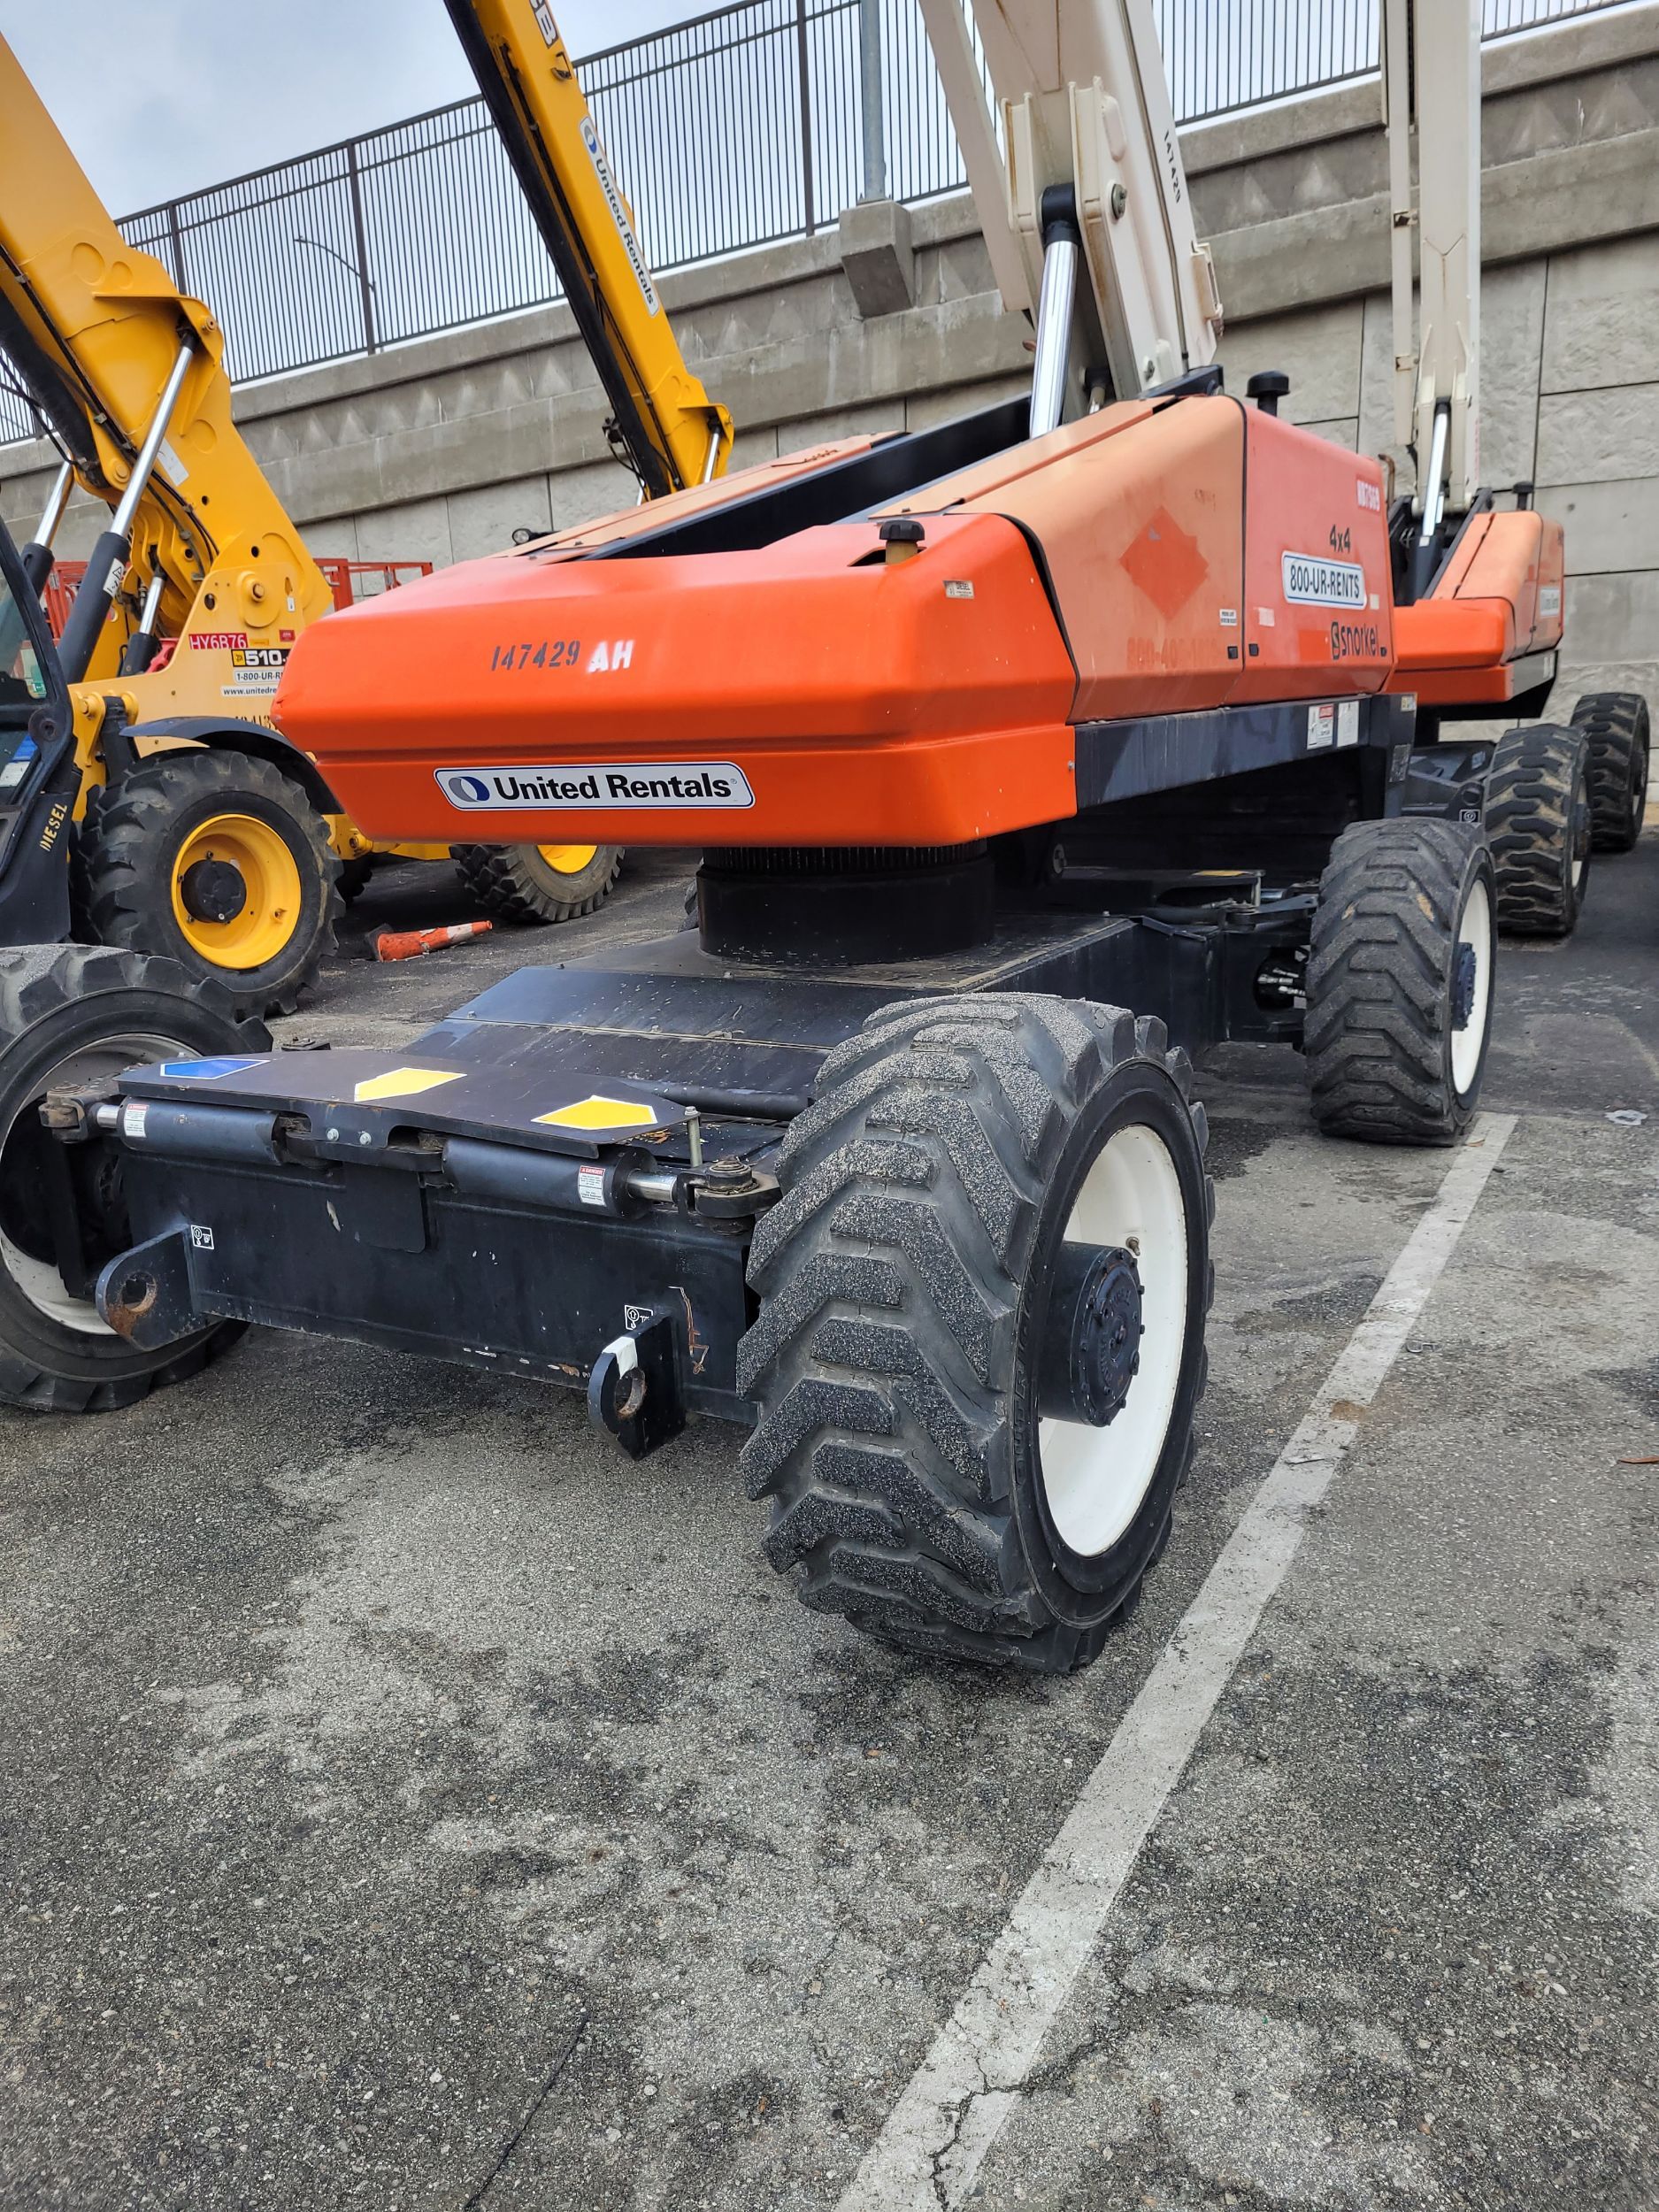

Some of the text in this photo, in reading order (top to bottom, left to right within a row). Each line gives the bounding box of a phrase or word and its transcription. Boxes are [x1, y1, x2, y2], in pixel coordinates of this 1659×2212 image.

[595, 158, 654, 304] United Rentals
[1329, 524, 1351, 553] 4x4
[1290, 565, 1360, 599] 800-UR-RENTS
[189, 634, 247, 649] HY6B76
[491, 640, 634, 673] 147429 AH
[1341, 623, 1379, 657] snorkel
[493, 772, 733, 801] United Rentals
[39, 803, 68, 852] DIESEL
